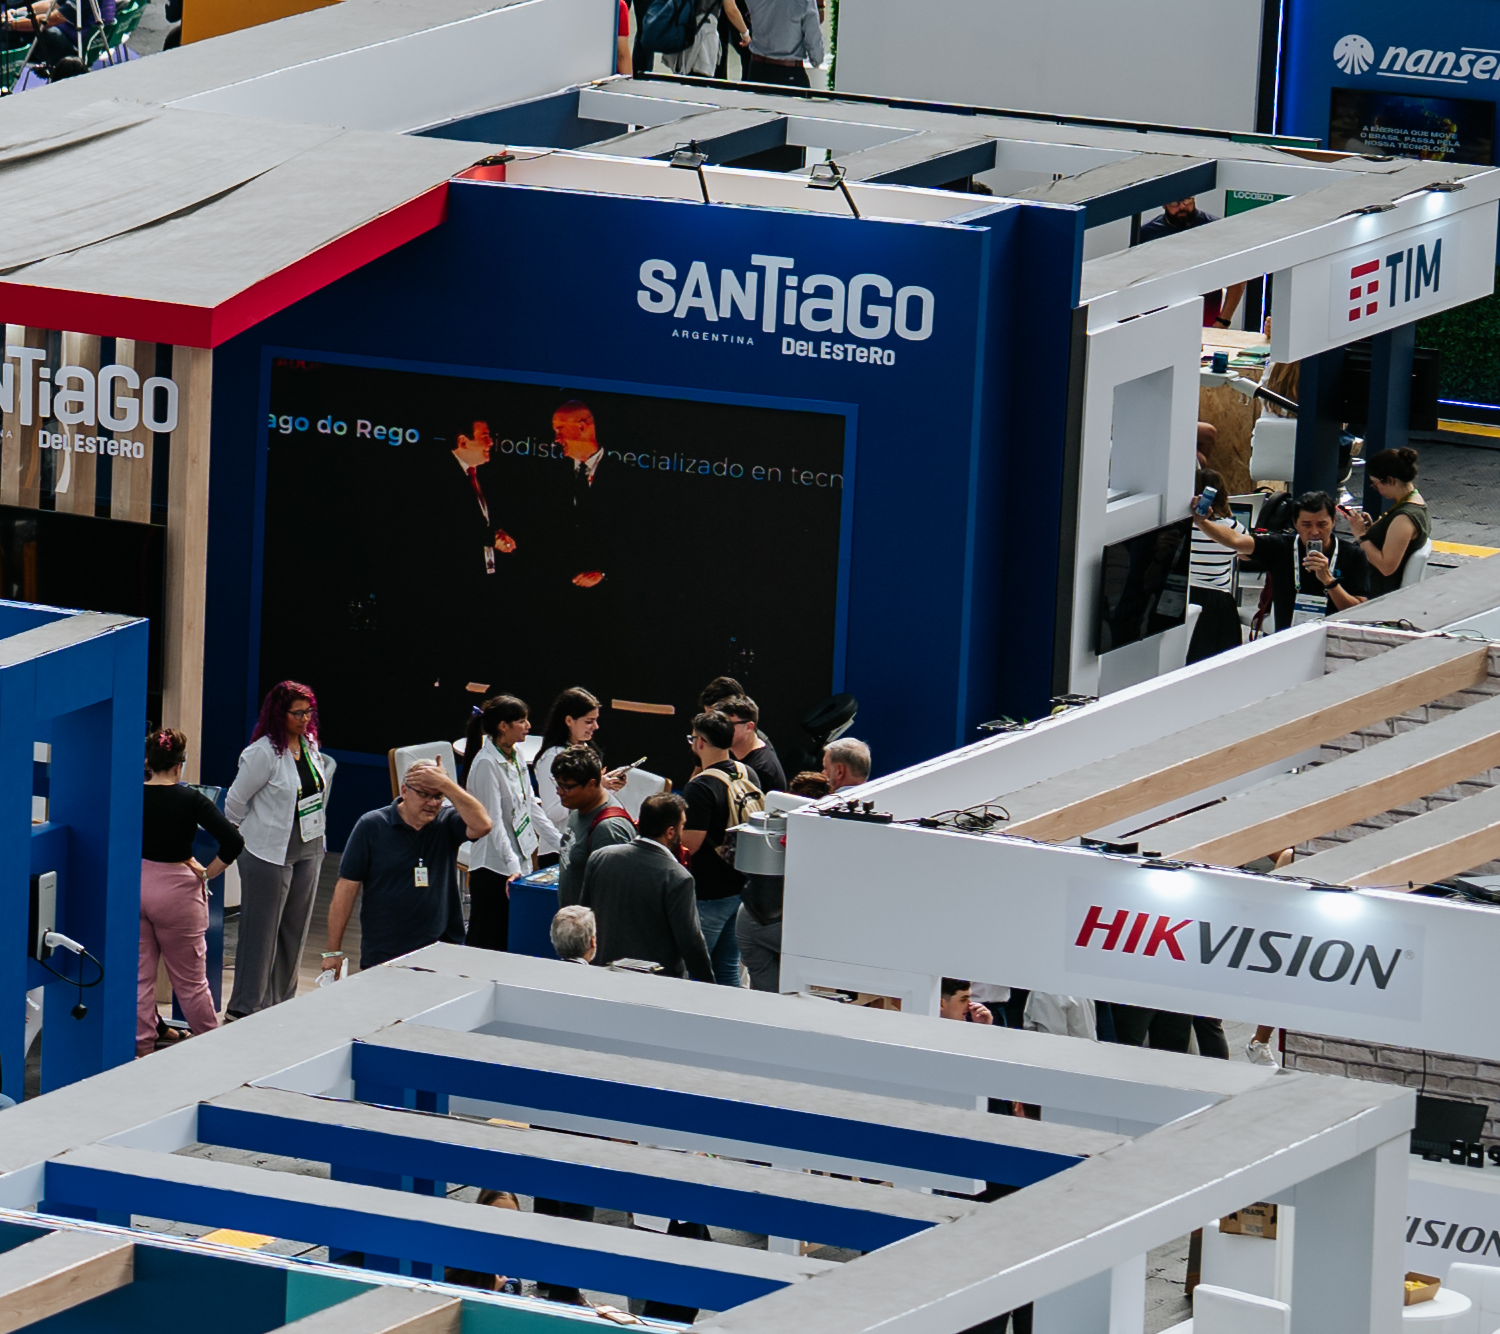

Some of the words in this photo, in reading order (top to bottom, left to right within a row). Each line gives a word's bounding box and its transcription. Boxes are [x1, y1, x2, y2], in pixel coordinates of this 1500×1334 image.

[1379, 46, 1500, 81] nanse
[1386, 238, 1442, 309] TIM
[671, 329, 754, 346] ARGENTINA
[317, 415, 348, 436] do
[356, 418, 420, 446] Rego
[1075, 906, 1402, 990] HIKVISION
